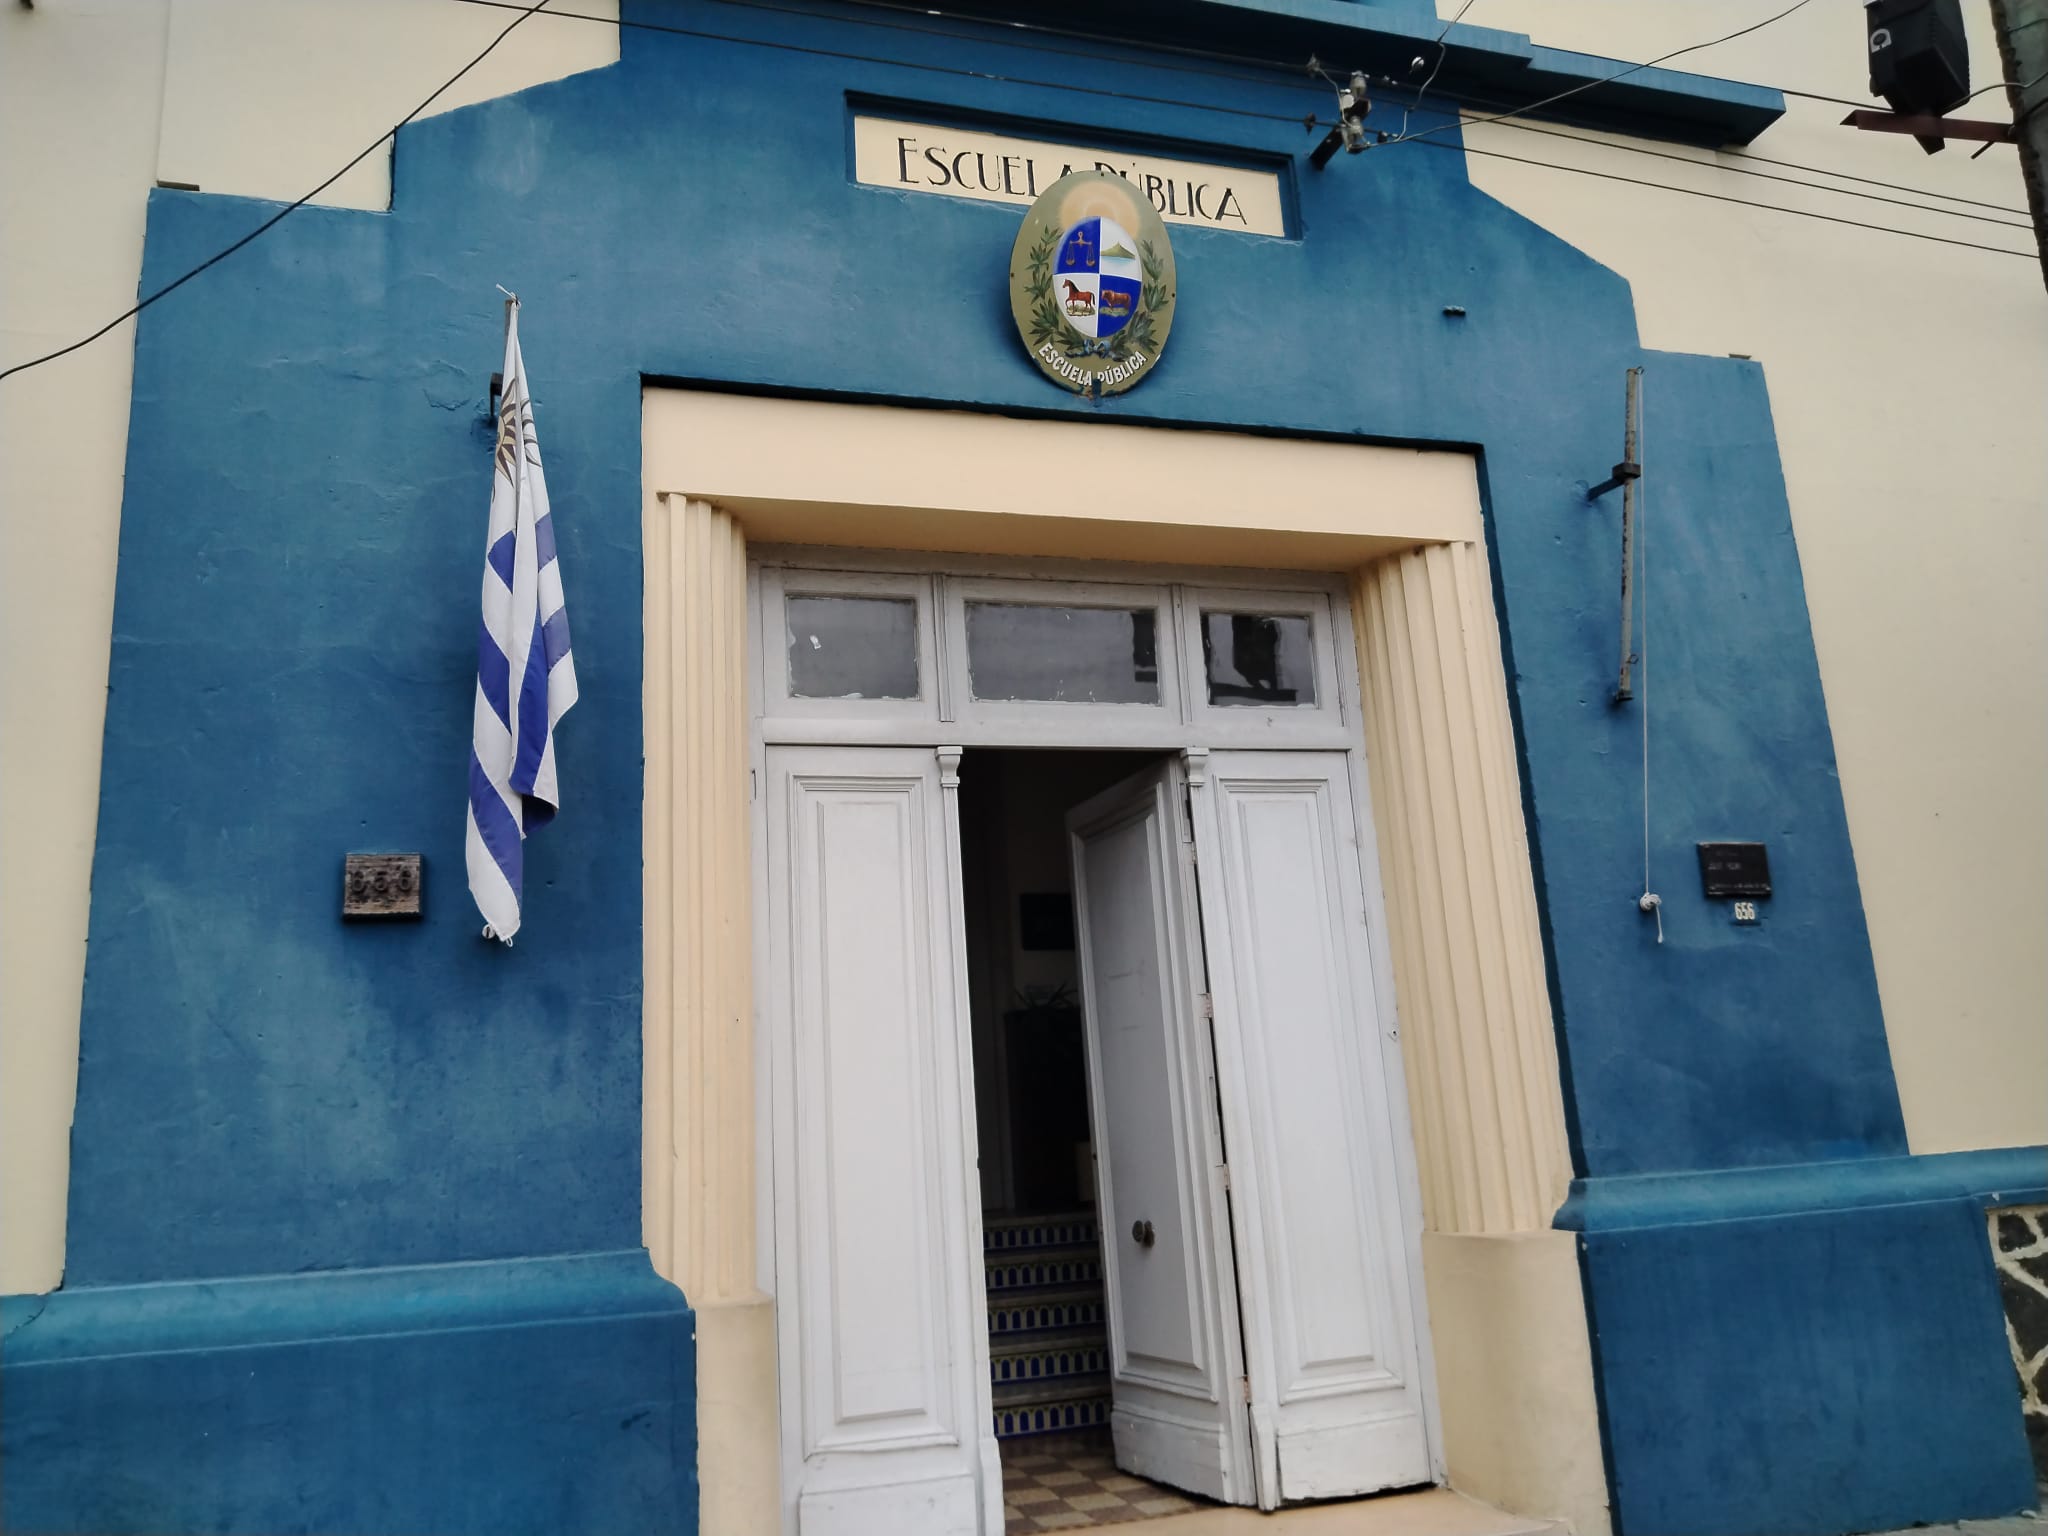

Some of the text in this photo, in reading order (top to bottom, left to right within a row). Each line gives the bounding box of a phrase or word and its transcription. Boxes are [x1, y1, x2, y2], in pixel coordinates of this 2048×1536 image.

[897, 137, 1248, 225] ESCUEL BLICA
[1039, 342, 1147, 386] ESCUELA PÚBLICA
[351, 863, 412, 893] 656
[1734, 902, 1755, 920] 656
